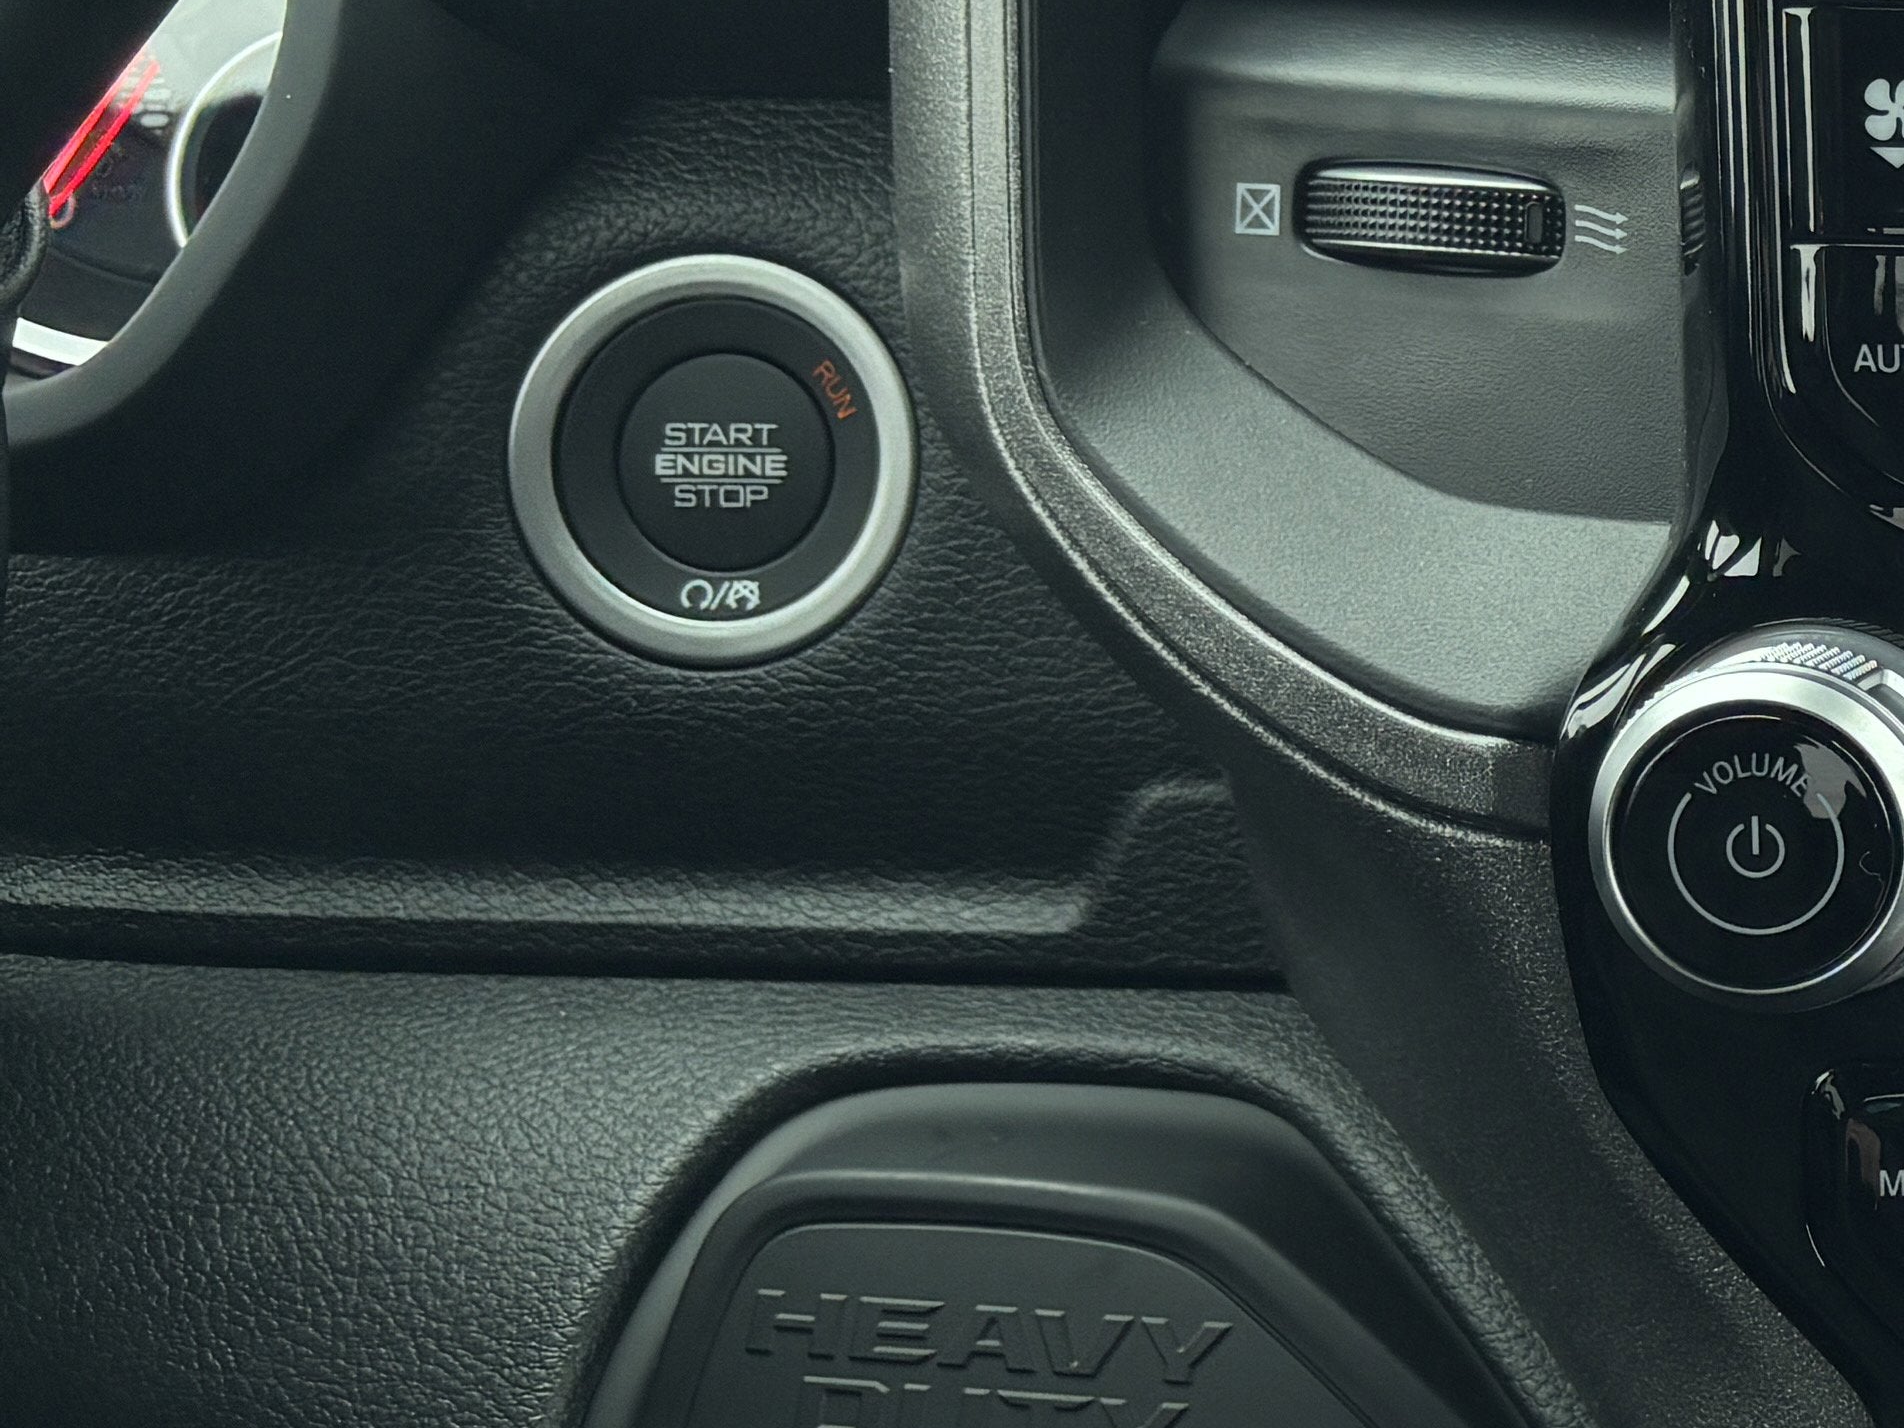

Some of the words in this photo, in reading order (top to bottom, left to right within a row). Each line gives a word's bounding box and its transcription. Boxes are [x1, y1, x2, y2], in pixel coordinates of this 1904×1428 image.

[812, 360, 858, 420] RUN
[663, 424, 778, 446] START
[655, 454, 788, 476] ENGINE
[673, 485, 769, 507] STOP
[1694, 753, 1809, 797] VOLUME
[745, 1288, 1233, 1384] HEAVY
